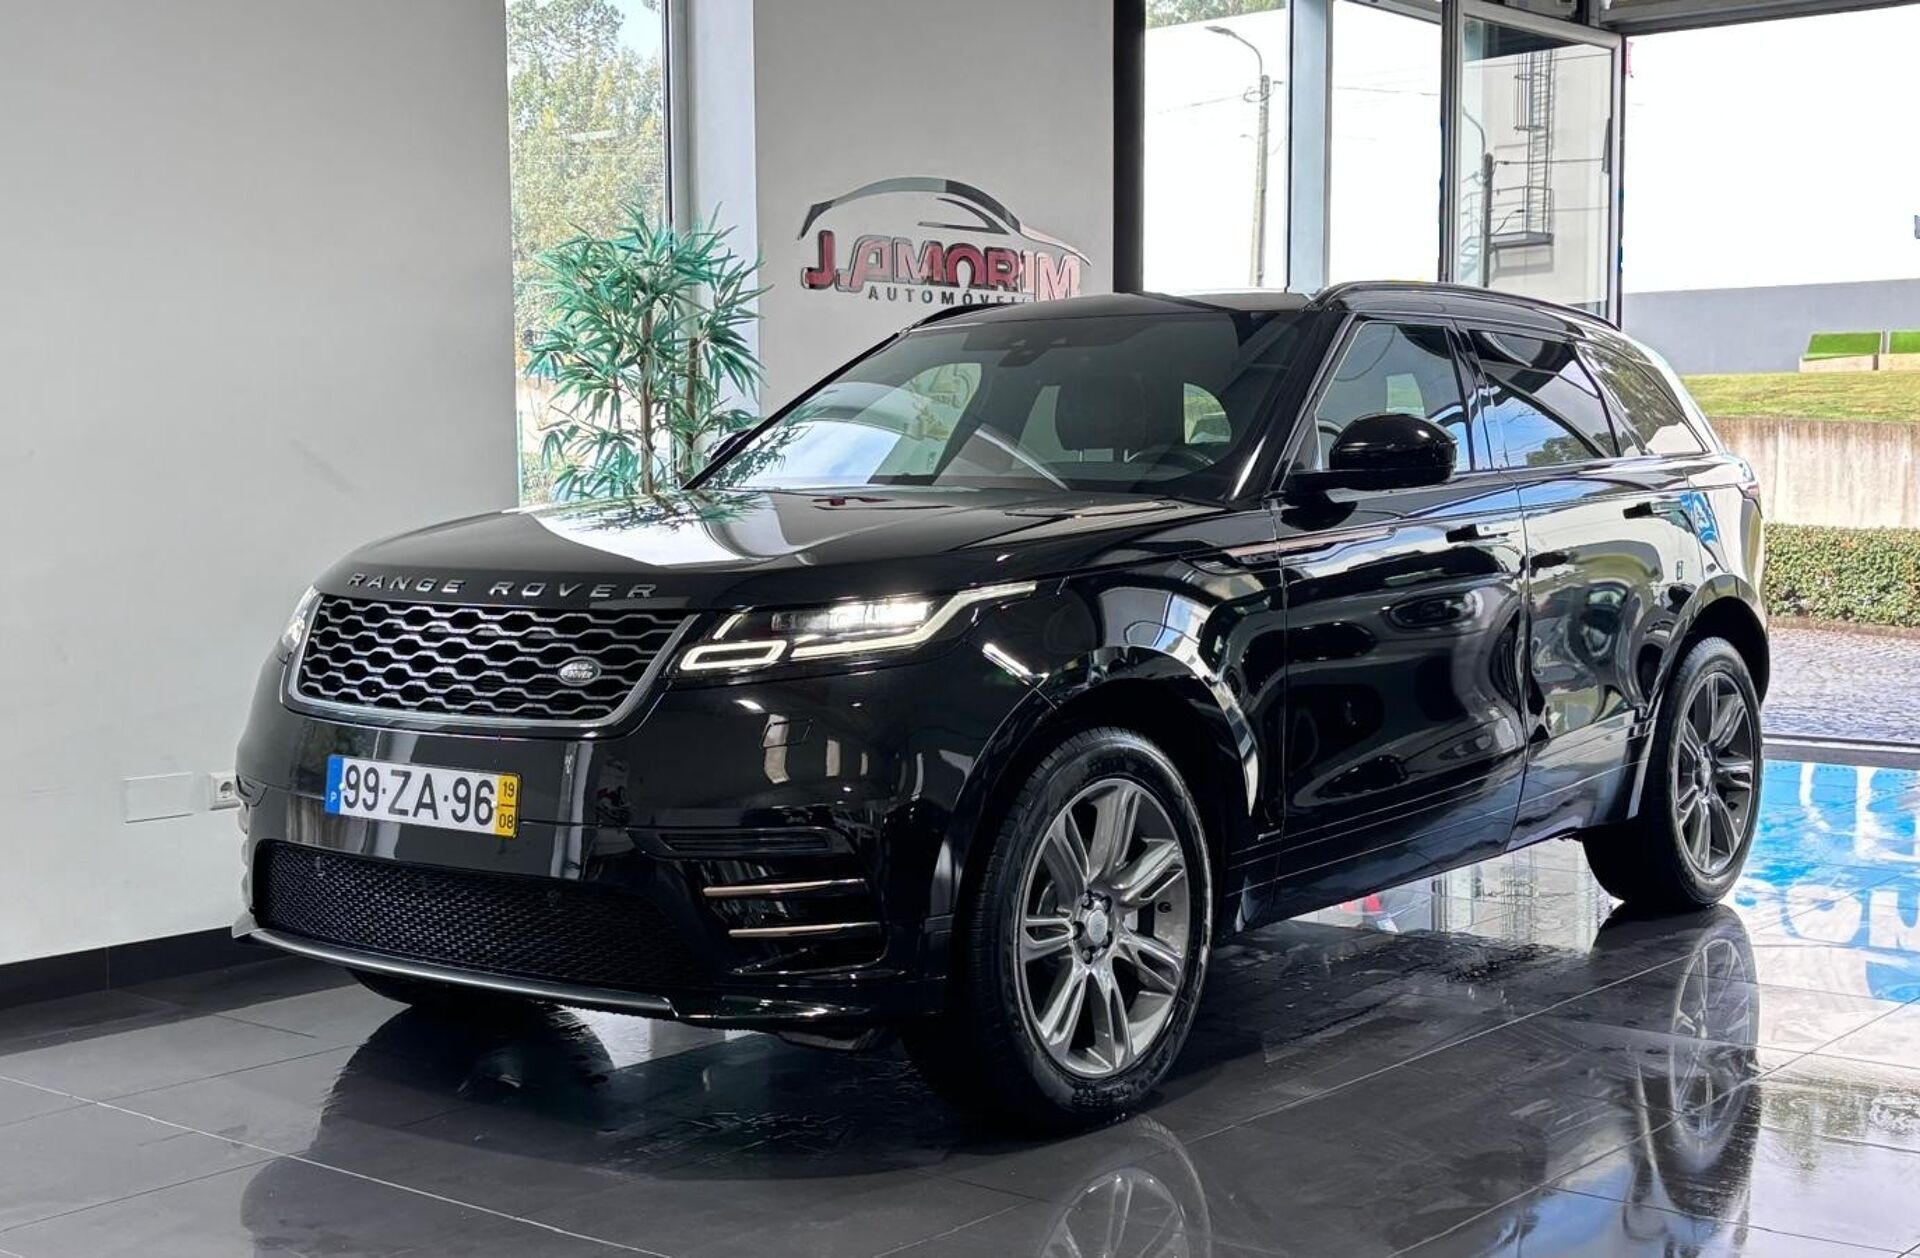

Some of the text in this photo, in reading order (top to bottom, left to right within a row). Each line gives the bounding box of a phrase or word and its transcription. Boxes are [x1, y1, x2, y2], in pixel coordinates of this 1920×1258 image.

[347, 573, 658, 599] RANGE ROVER
[502, 781, 515, 798] 19
[329, 793, 338, 803] P
[498, 814, 514, 829] 08
